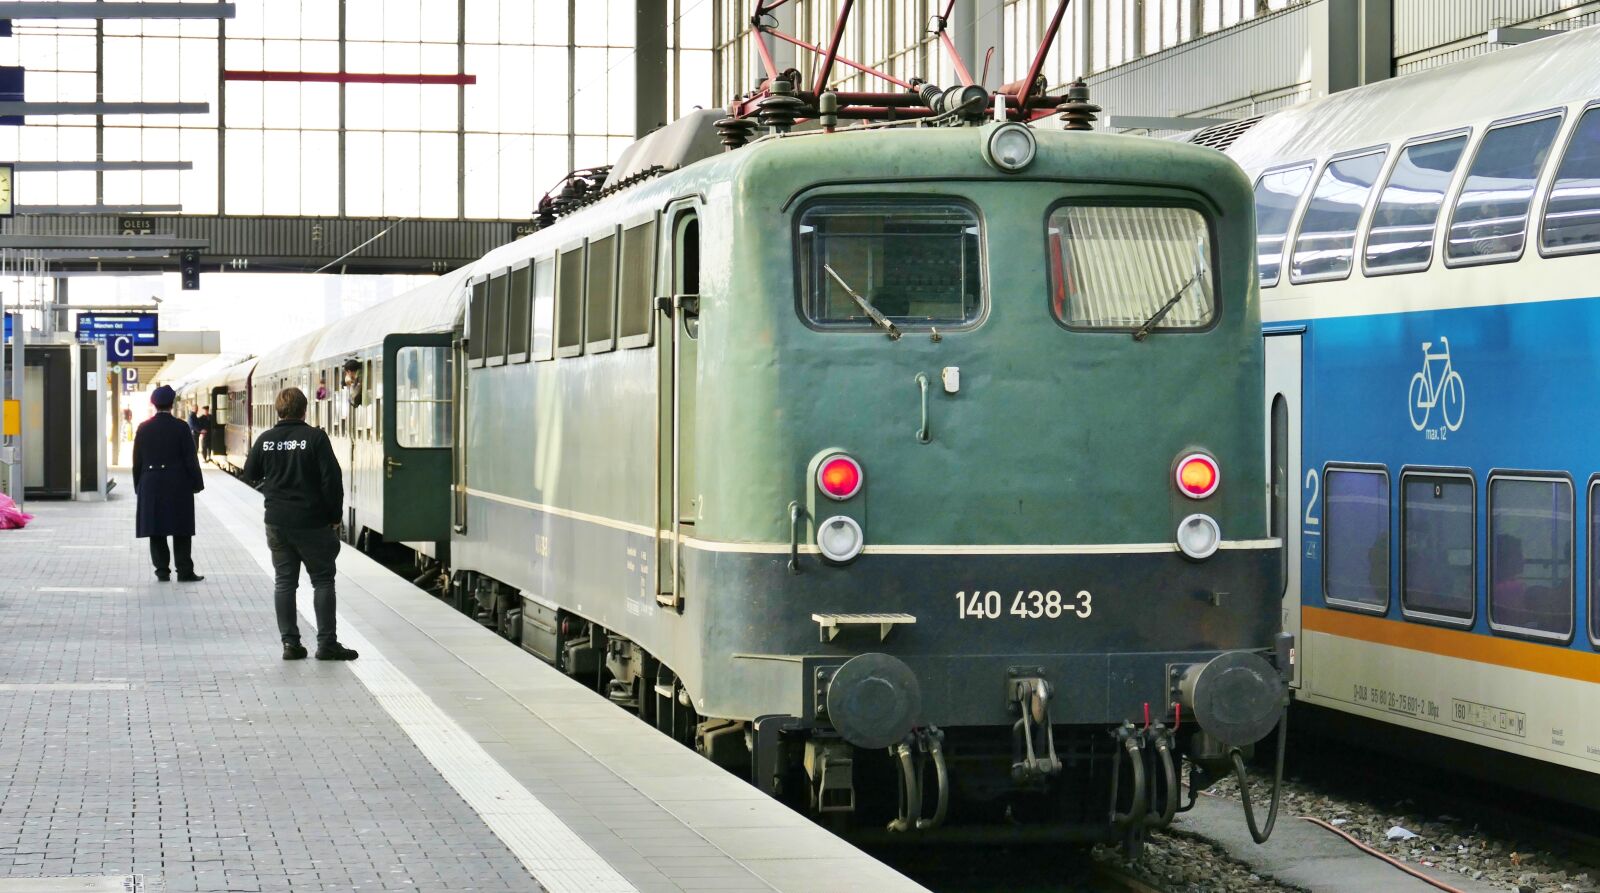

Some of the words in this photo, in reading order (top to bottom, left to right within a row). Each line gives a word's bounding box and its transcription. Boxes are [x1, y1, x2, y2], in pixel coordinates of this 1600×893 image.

[123, 220, 150, 228] GLEIS
[114, 336, 130, 357] C
[126, 368, 137, 381] D
[1425, 429, 1440, 440] max.
[1440, 425, 1447, 440] 12
[262, 441, 275, 451] 52
[277, 440, 307, 450] 8168-8
[1305, 468, 1319, 525] 2
[698, 494, 703, 520] 2
[955, 590, 1001, 619] 140
[1010, 590, 1092, 619] 438-3
